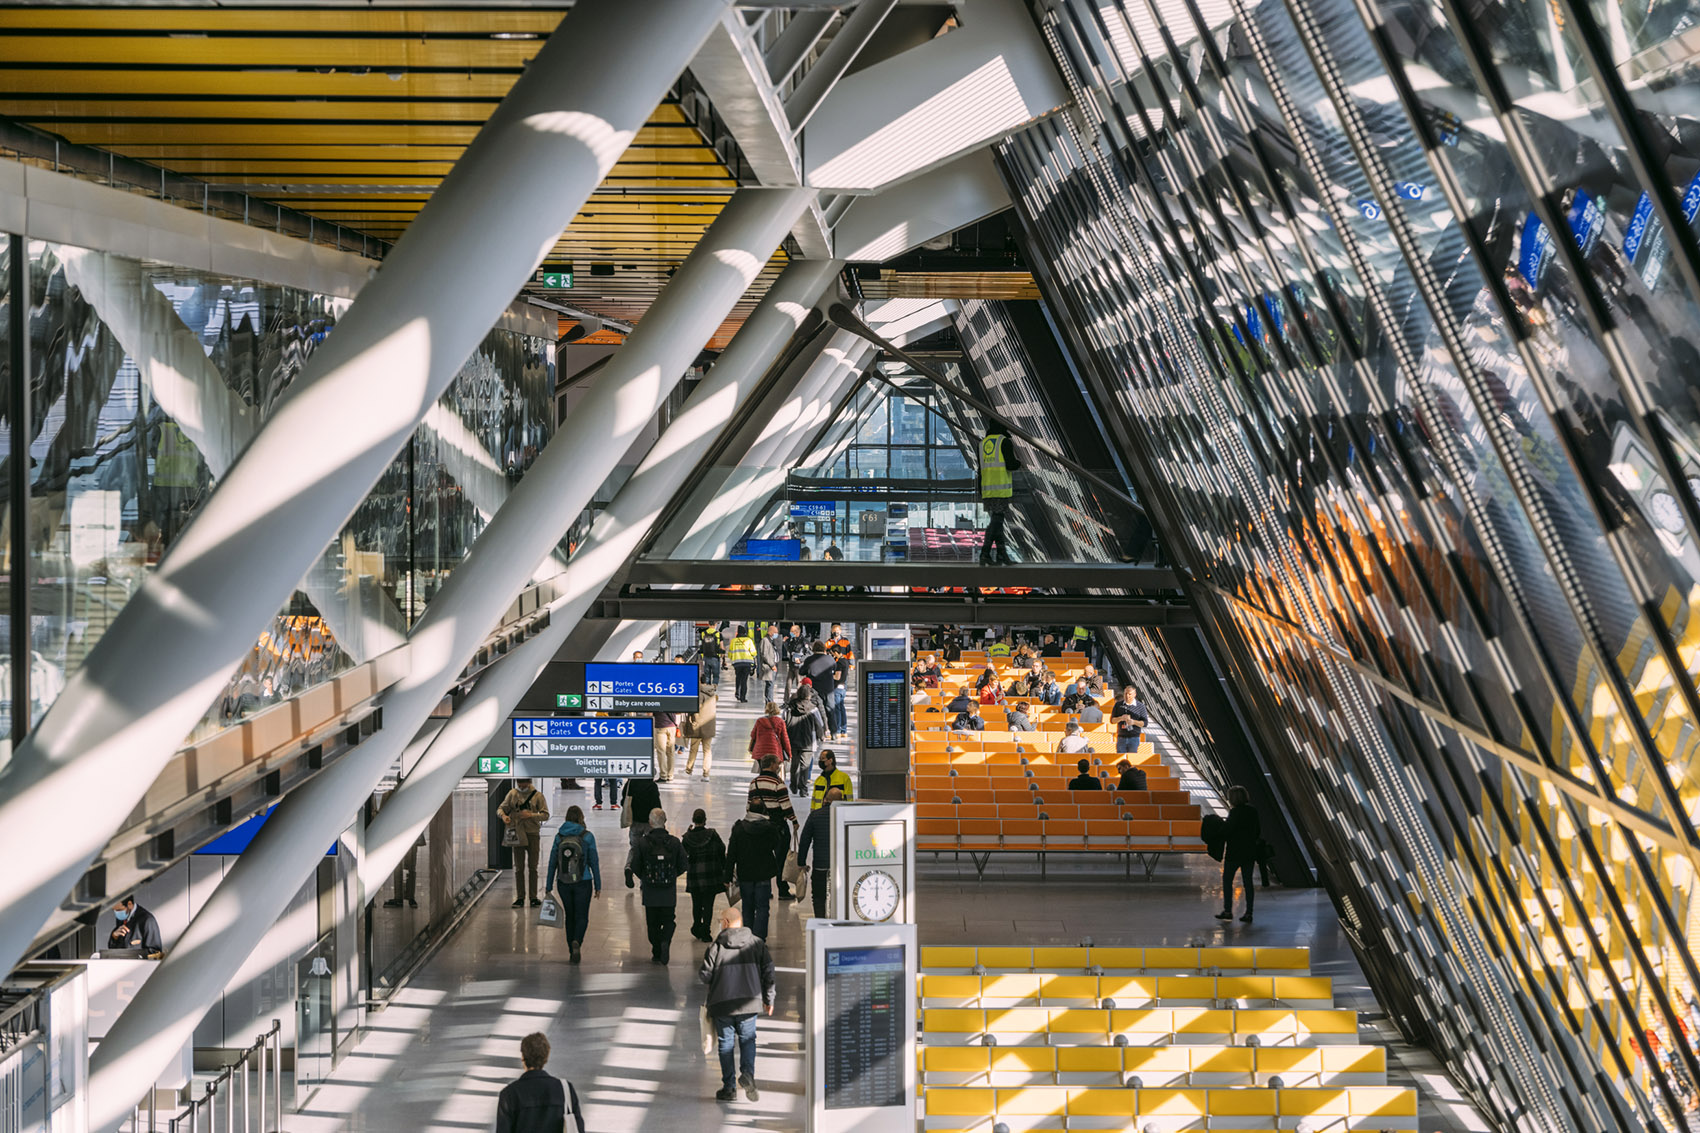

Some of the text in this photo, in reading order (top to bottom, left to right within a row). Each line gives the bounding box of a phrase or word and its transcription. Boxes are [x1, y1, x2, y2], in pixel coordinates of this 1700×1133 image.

[638, 682, 685, 694] C56-63
[578, 721, 635, 735] C56-63
[550, 744, 568, 752] Baby
[575, 758, 607, 766] Toilettes
[855, 849, 897, 859] ROLEX
